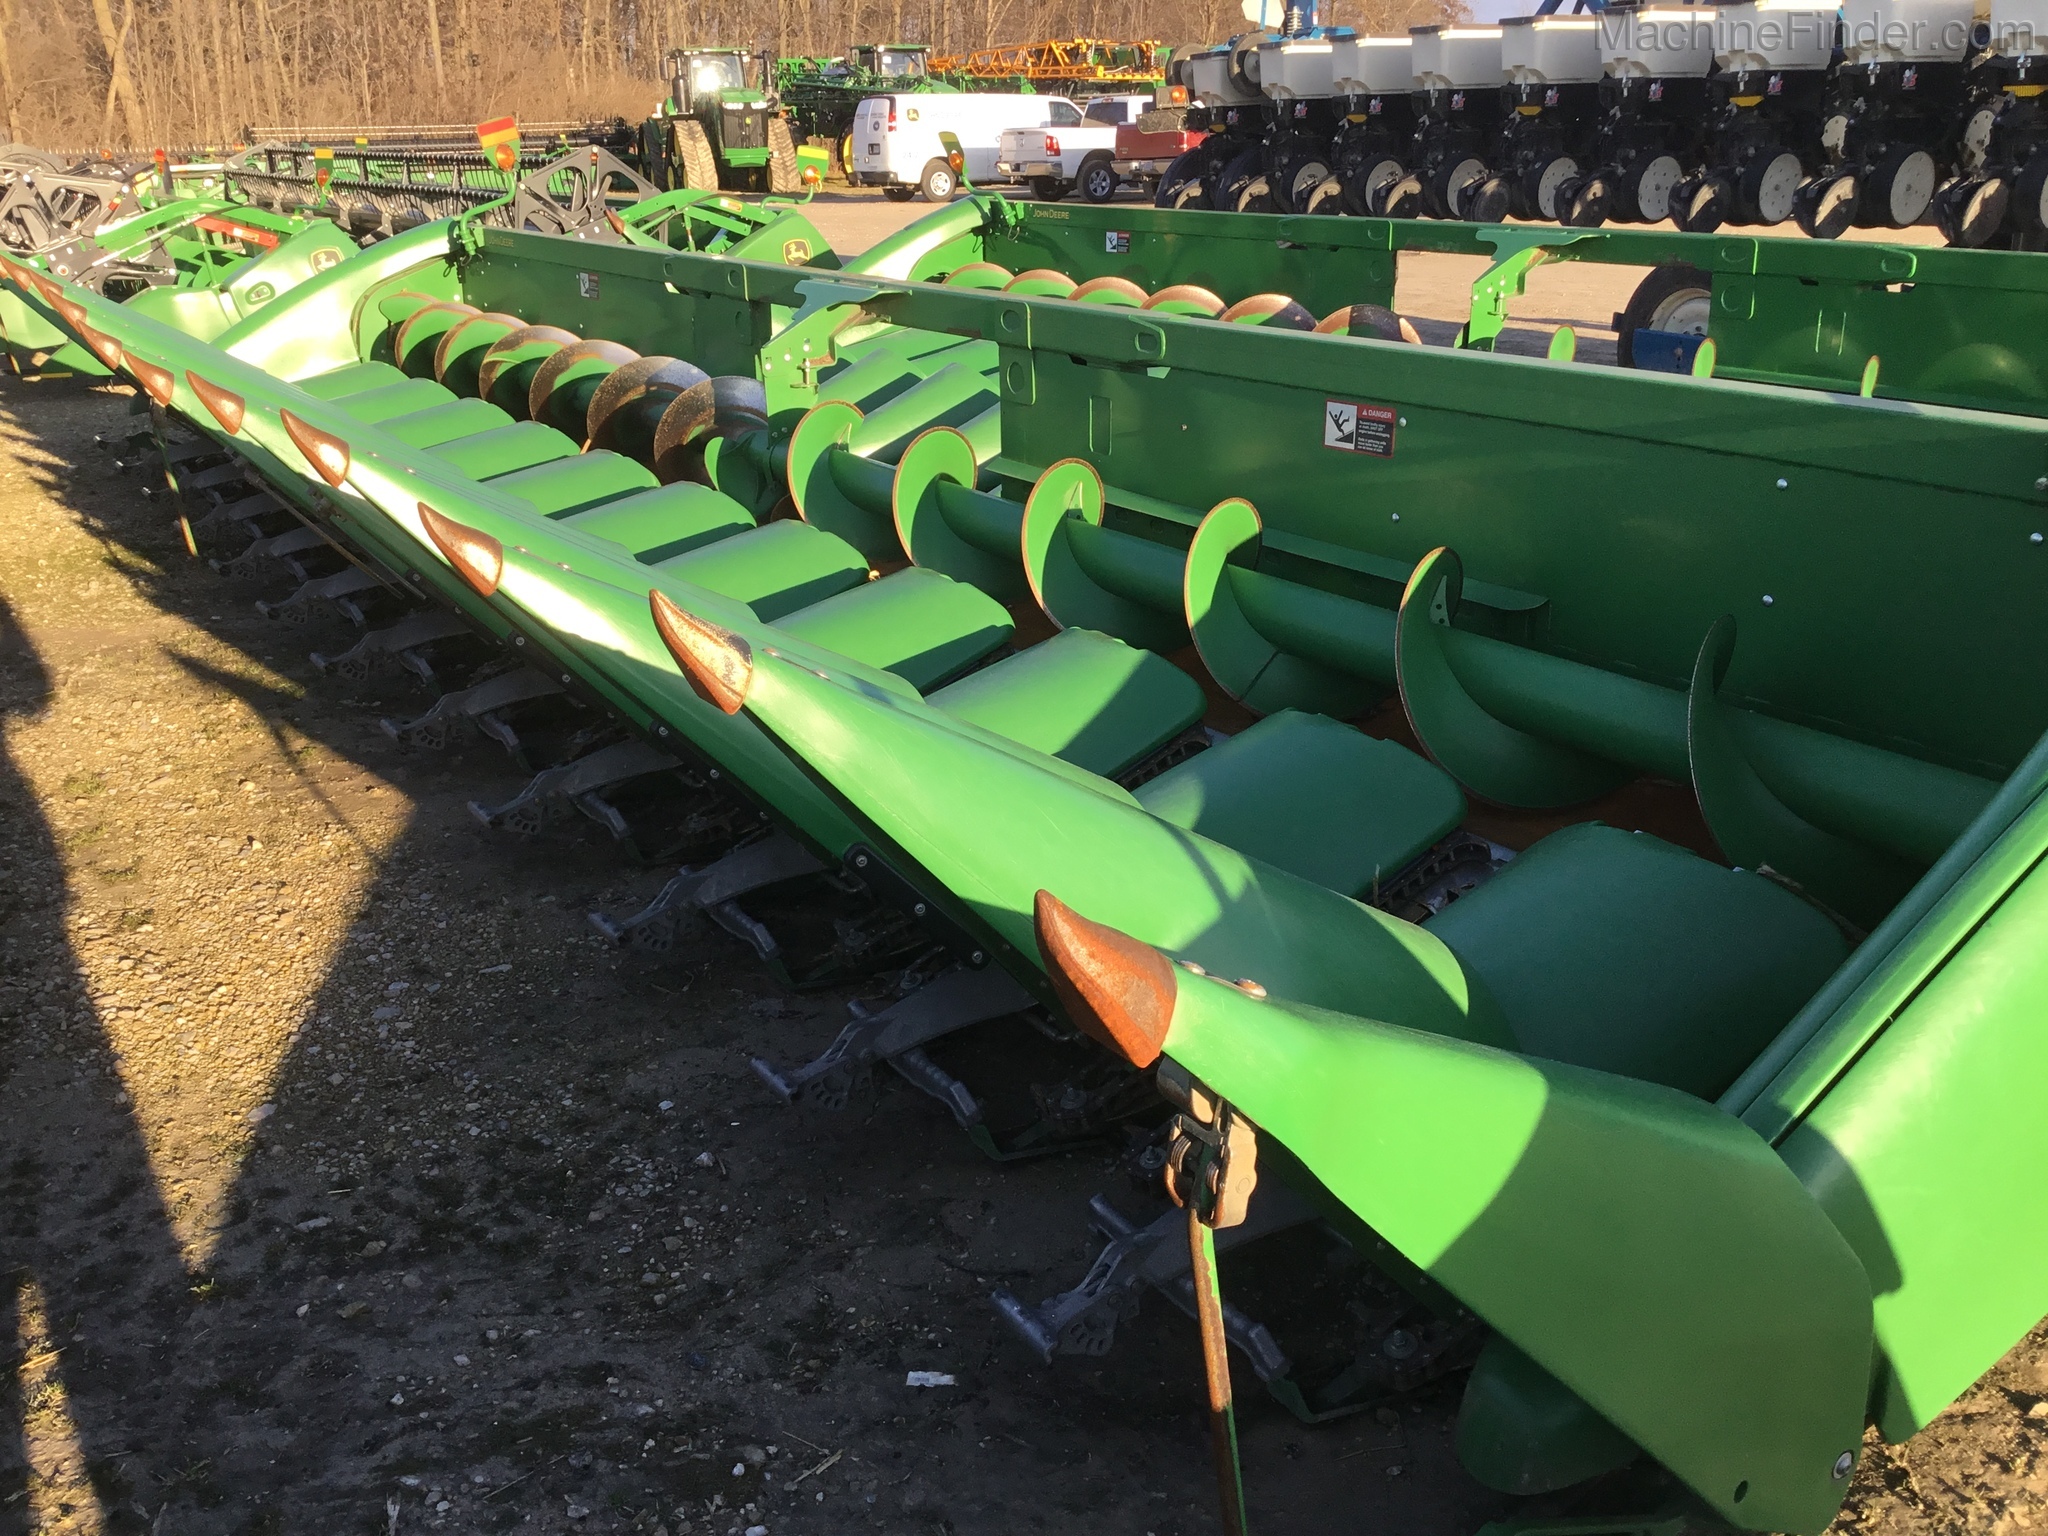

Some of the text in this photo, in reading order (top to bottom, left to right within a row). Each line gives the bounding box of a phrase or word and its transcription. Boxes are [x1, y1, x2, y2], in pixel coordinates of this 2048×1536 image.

[1033, 208, 1070, 220] JOHN DEERE
[1368, 409, 1392, 419] DANGER
